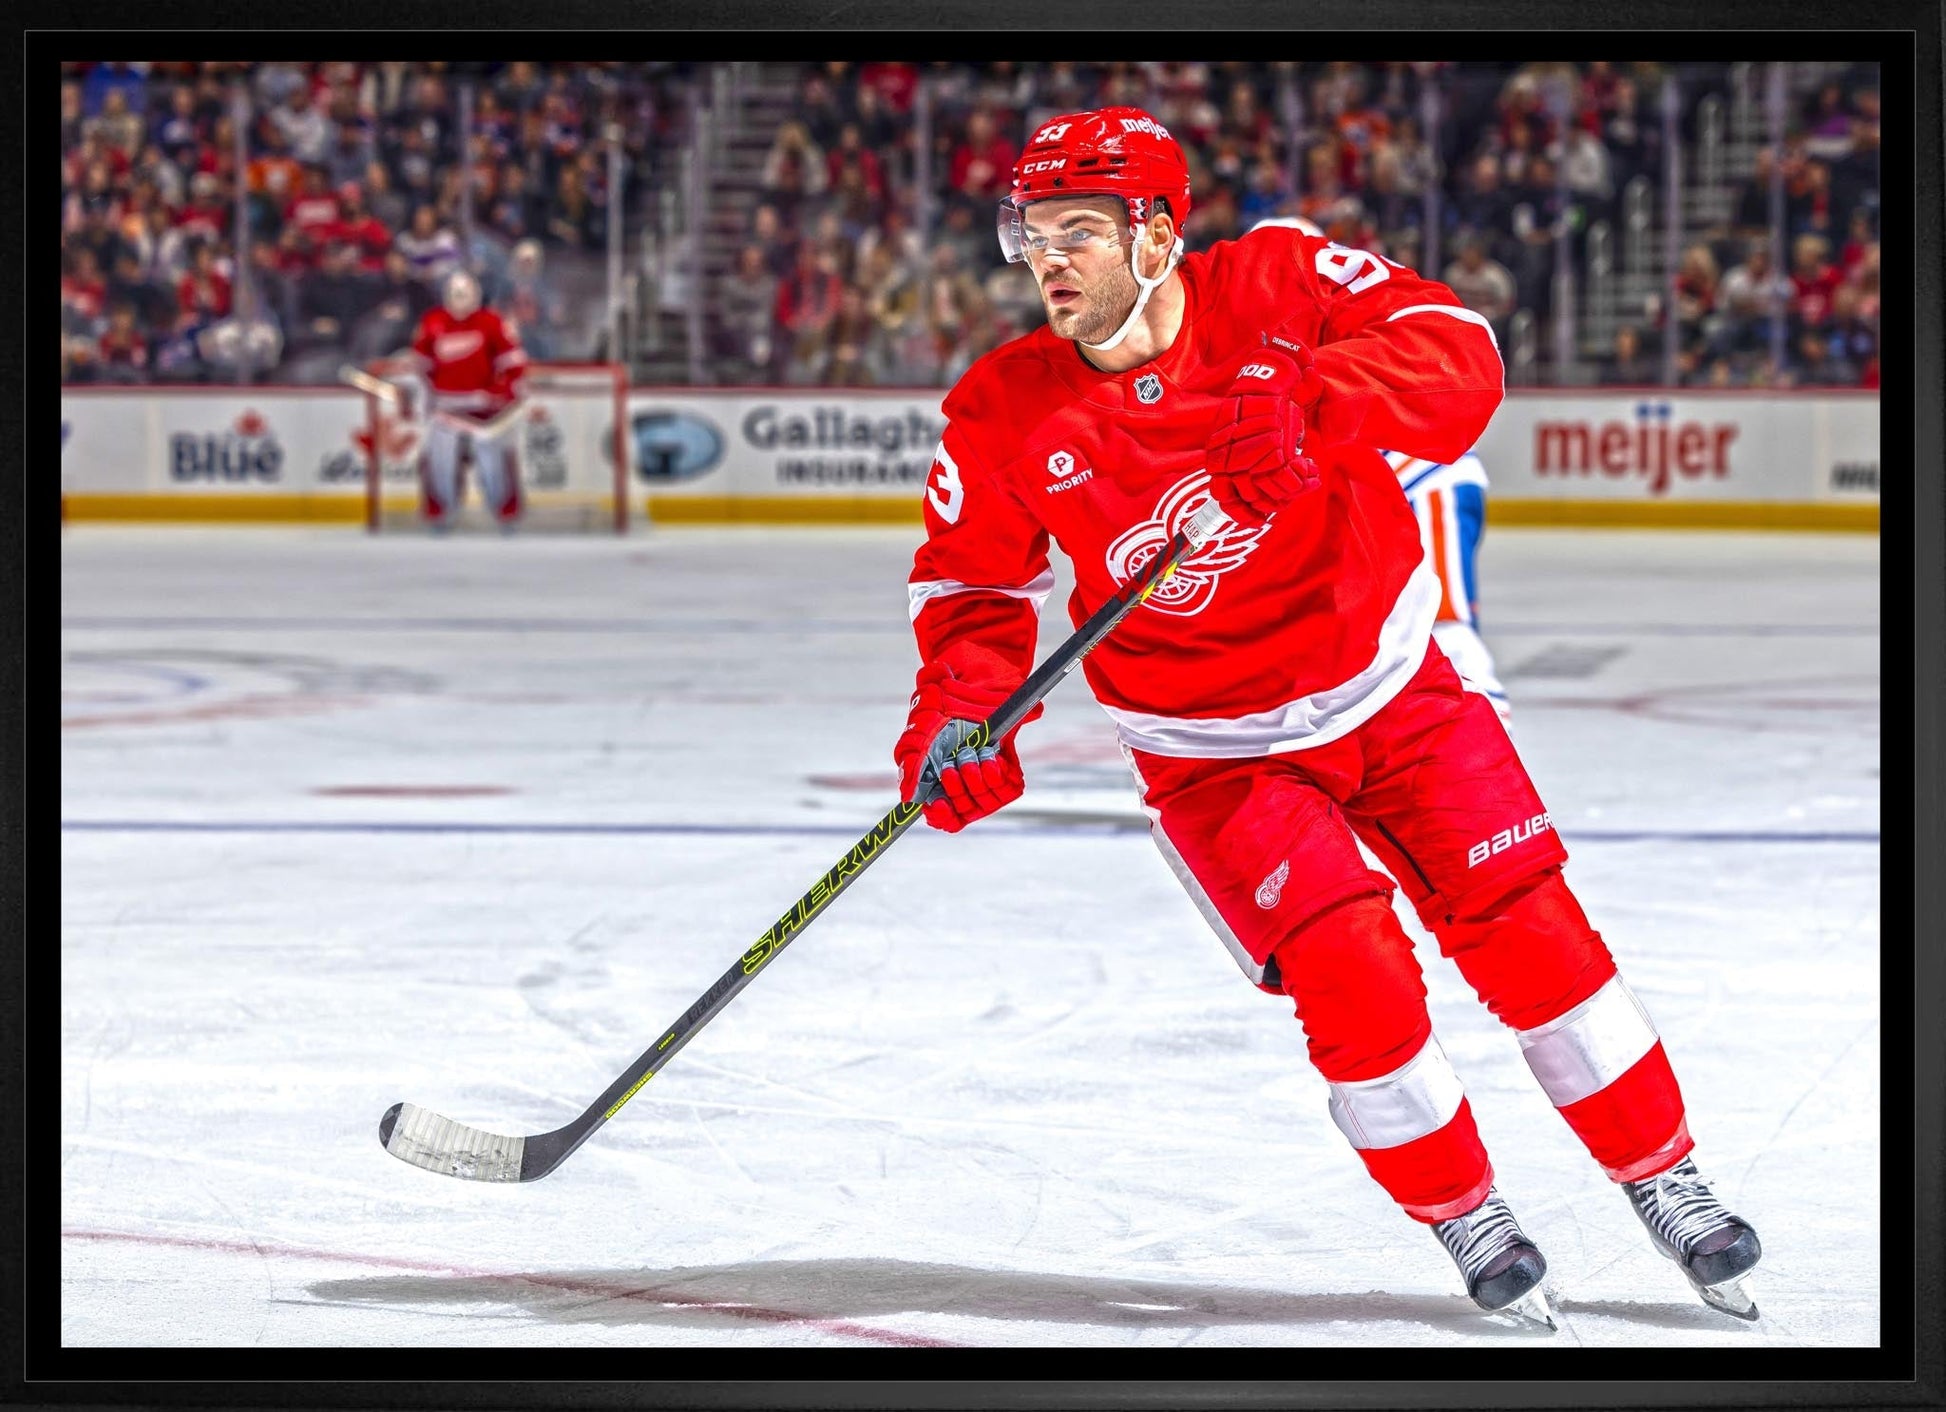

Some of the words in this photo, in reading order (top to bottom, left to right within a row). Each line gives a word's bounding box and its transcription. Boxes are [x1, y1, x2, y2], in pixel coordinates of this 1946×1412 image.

[1023, 158, 1067, 174] CCM
[1315, 241, 1406, 295] 9
[168, 431, 285, 483] Blue
[742, 405, 945, 461] Gallagh
[1535, 403, 1738, 493] meijer
[1045, 467, 1093, 495] PRIORITY
